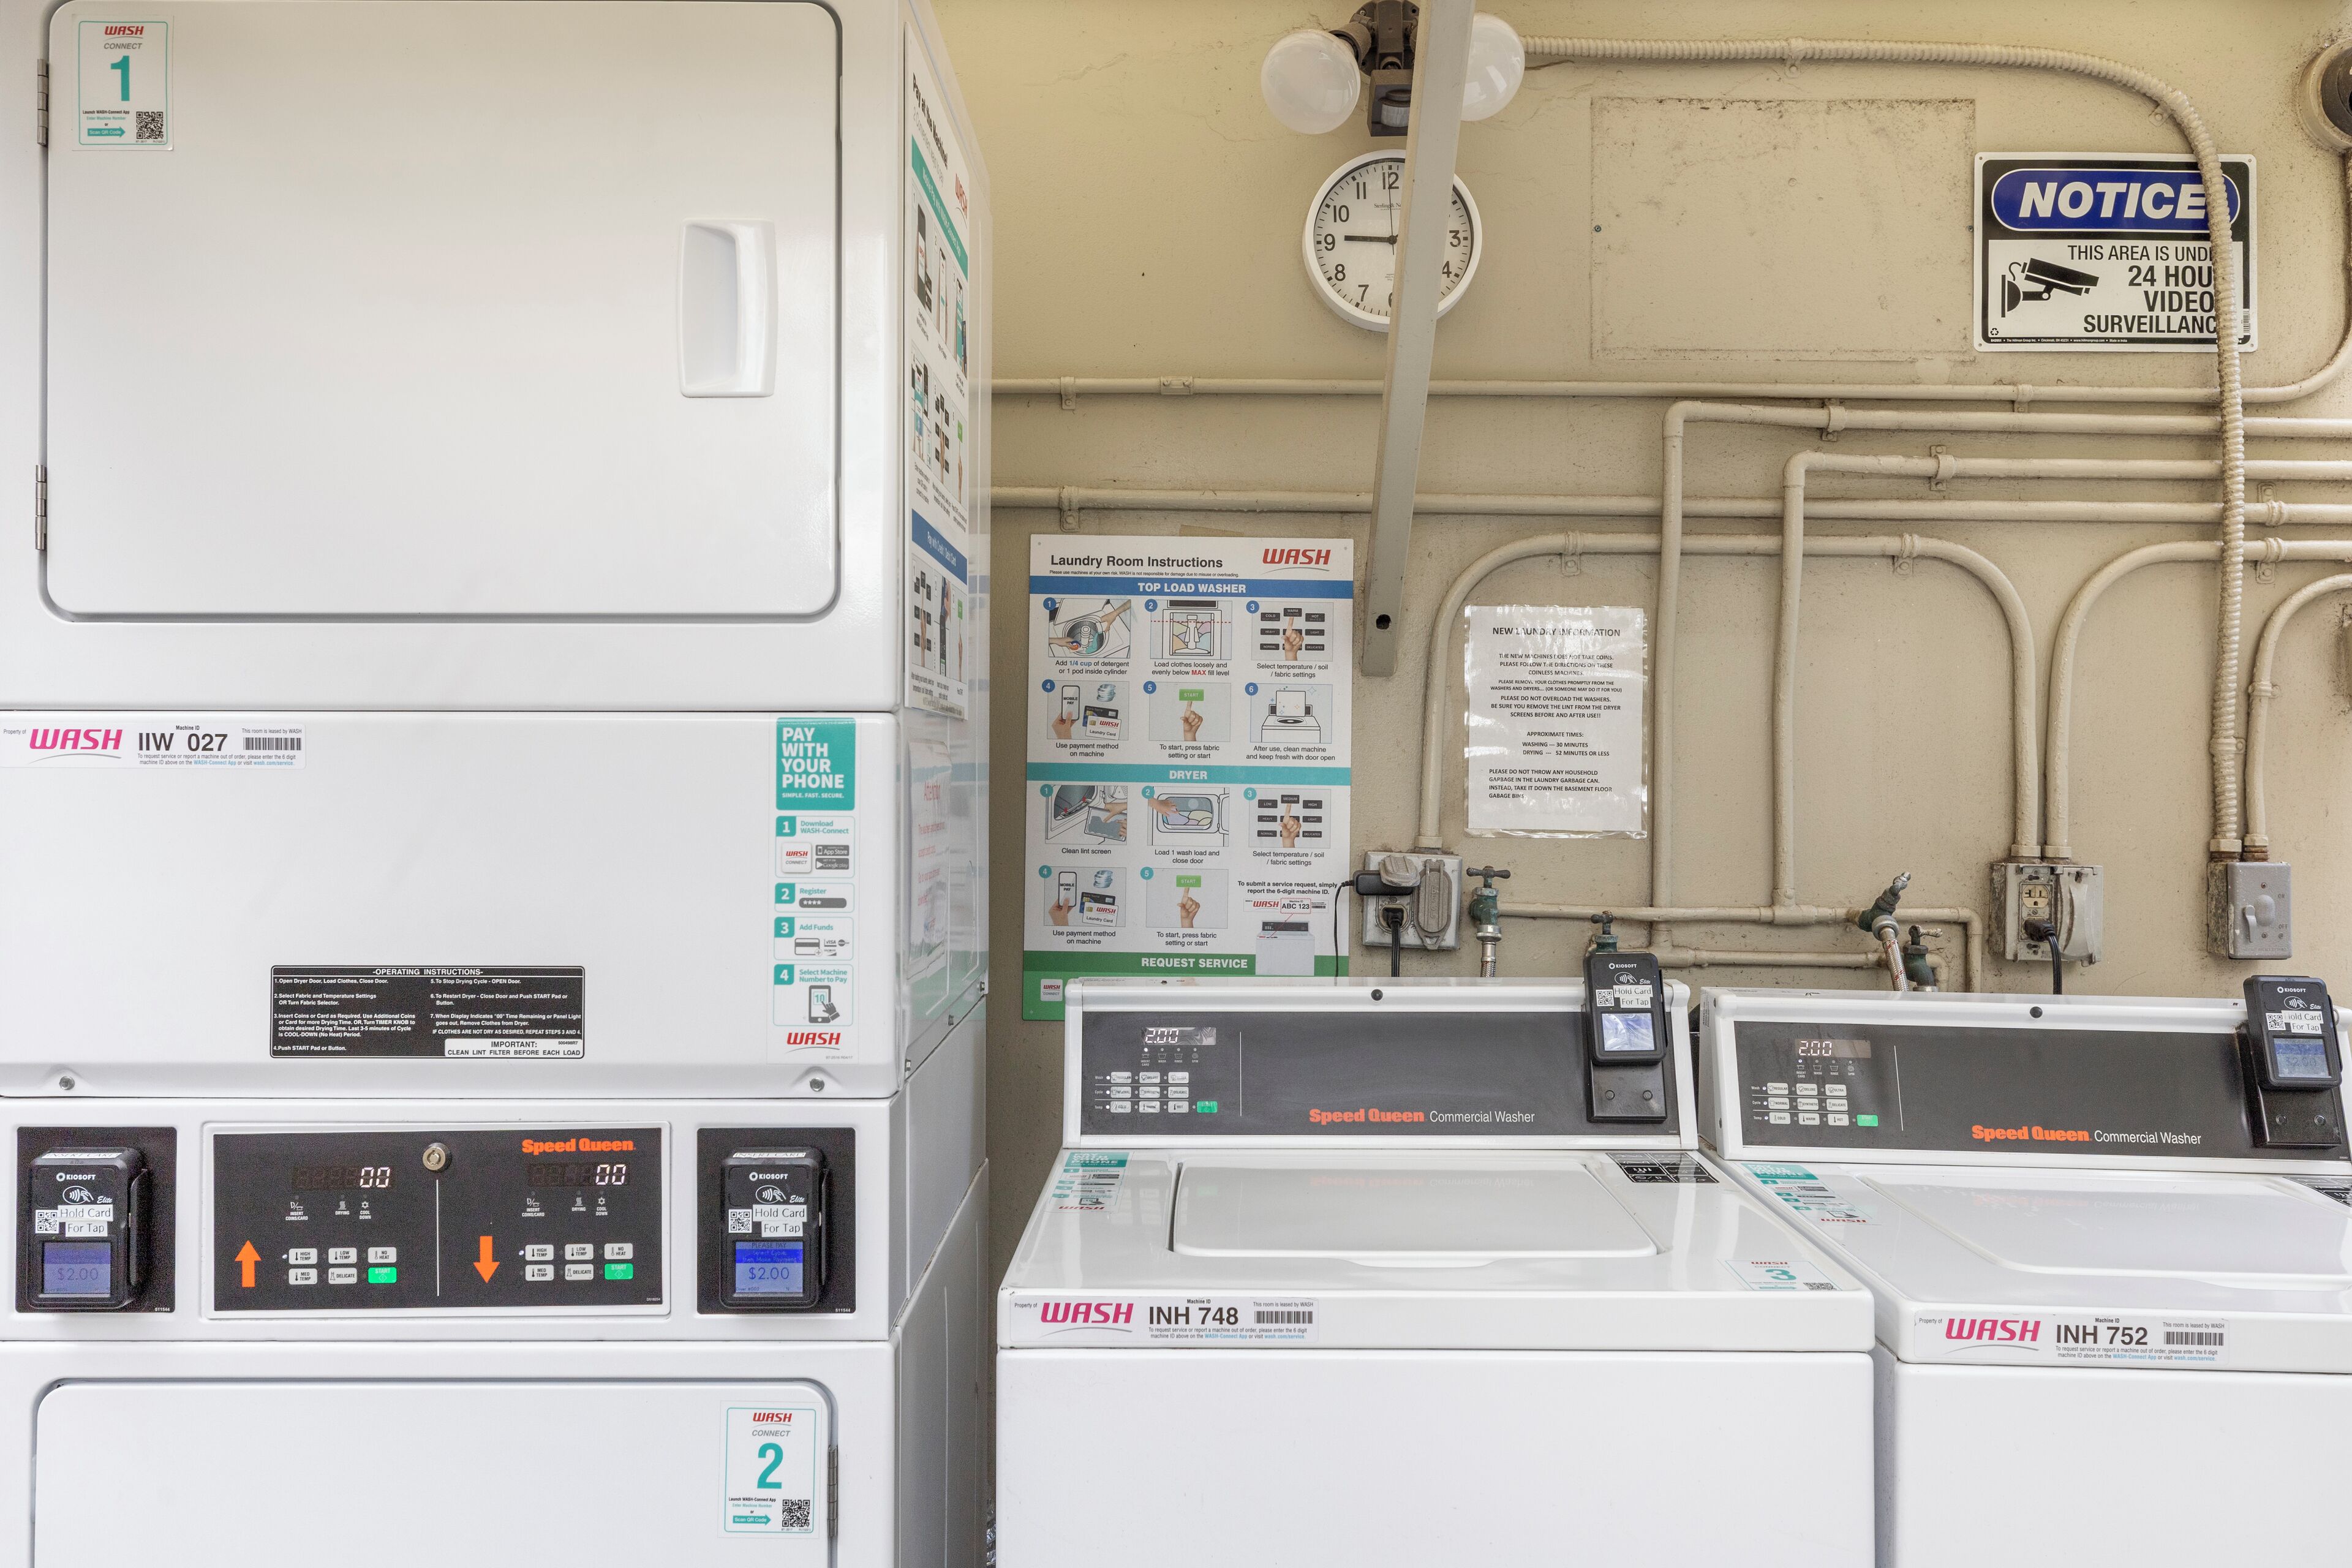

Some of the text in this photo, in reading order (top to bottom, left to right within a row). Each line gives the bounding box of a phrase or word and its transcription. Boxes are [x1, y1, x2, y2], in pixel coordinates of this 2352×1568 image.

[105, 26, 144, 36] WASH
[111, 55, 130, 101] 1
[1382, 172, 1399, 190] 12
[955, 173, 968, 219] WASH
[1356, 182, 1366, 199] 11
[2019, 181, 2206, 219] NOTICE
[1333, 205, 1349, 222] 10
[1324, 233, 1335, 251] 9
[1449, 230, 1461, 247] 3
[2067, 244, 2212, 262] THIS AREA IS UND
[1335, 263, 1346, 281] 8
[1442, 261, 1452, 278] 4
[2128, 266, 2212, 288] 24 HOU
[1358, 284, 1369, 302] 7
[2144, 290, 2214, 312] VIDEO
[2084, 315, 2216, 334] SURVEILLANC
[1051, 554, 1223, 568] Laundry Room Instructions
[1262, 548, 1331, 565] WASH
[1137, 582, 1246, 593] TOP LOAD WASHER
[29, 729, 123, 750] WASH
[138, 733, 227, 752] IIW 027
[782, 727, 815, 741] PAY
[782, 743, 828, 757] WITH
[781, 758, 831, 773] YOUR
[782, 774, 844, 788] PHONE
[1169, 771, 1207, 780] DRYER
[782, 821, 790, 833] 1
[782, 888, 790, 900] 2
[781, 922, 789, 933] 3
[1142, 957, 1247, 969] REQUEST SERVICE
[780, 970, 788, 981] 4
[786, 1033, 840, 1045] WASH
[1145, 1029, 1178, 1043] 2.00
[1799, 1041, 1832, 1056] 2.00
[1310, 1109, 1535, 1126] Speed Queen Commercial Washer
[1972, 1125, 2201, 1144] Speed Queen Commercial Washer
[522, 1138, 633, 1155] Speed Queen
[359, 1167, 390, 1188] 00
[595, 1164, 627, 1186] 00
[755, 1208, 805, 1218] Hold Card
[764, 1224, 800, 1234] For Tap
[748, 1267, 790, 1280] $2.00
[1041, 1302, 1134, 1323] WASH
[1150, 1306, 1238, 1325] INH 748
[1946, 1318, 2041, 1341] WASH
[2057, 1324, 2147, 1345] INH 752
[753, 1412, 792, 1422] WASH
[757, 1442, 783, 1489] 2
